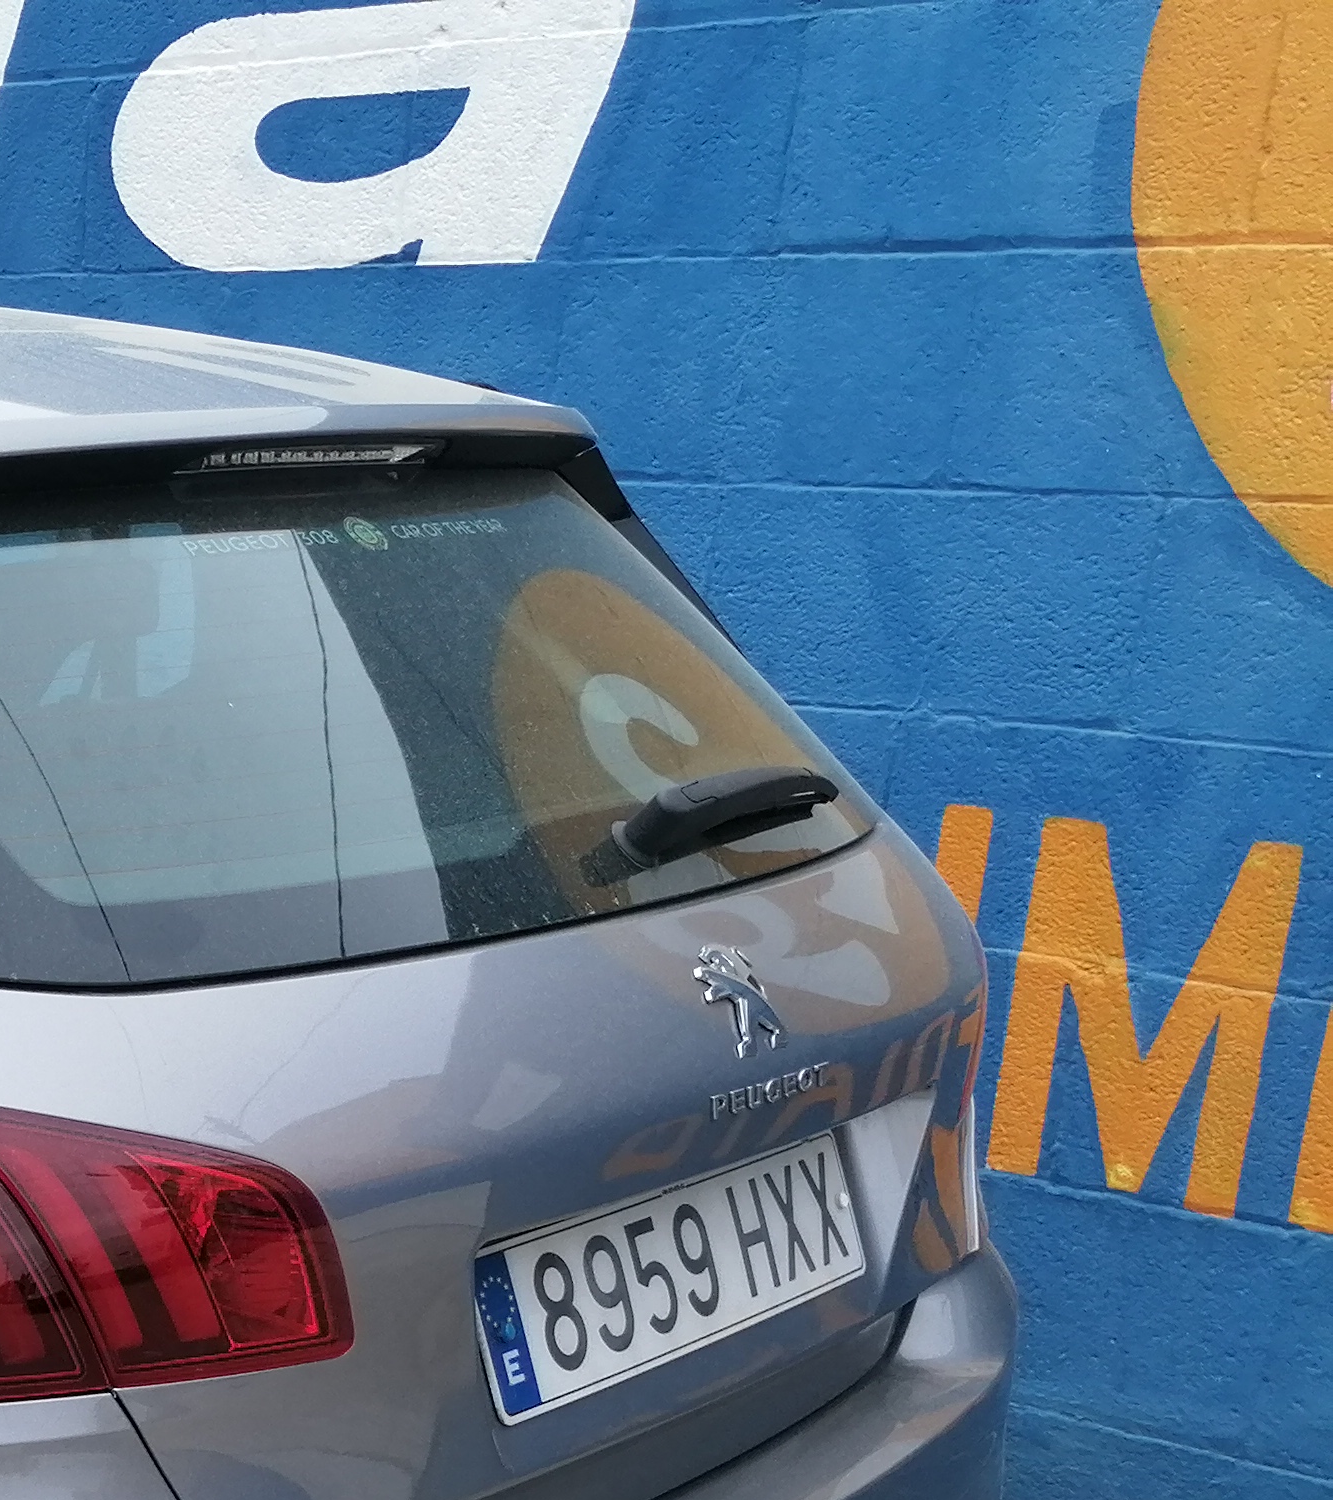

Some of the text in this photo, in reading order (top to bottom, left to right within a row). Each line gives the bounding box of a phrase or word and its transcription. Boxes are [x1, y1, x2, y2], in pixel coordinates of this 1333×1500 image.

[183, 531, 293, 557] PEUGEOT
[297, 528, 339, 546] 308
[390, 522, 426, 540] CAR
[421, 521, 444, 538] OF
[442, 519, 476, 536] THE
[709, 1061, 830, 1120] PEUGEOT
[533, 1151, 850, 1371] 8959 HXX
[502, 1348, 526, 1387] E
